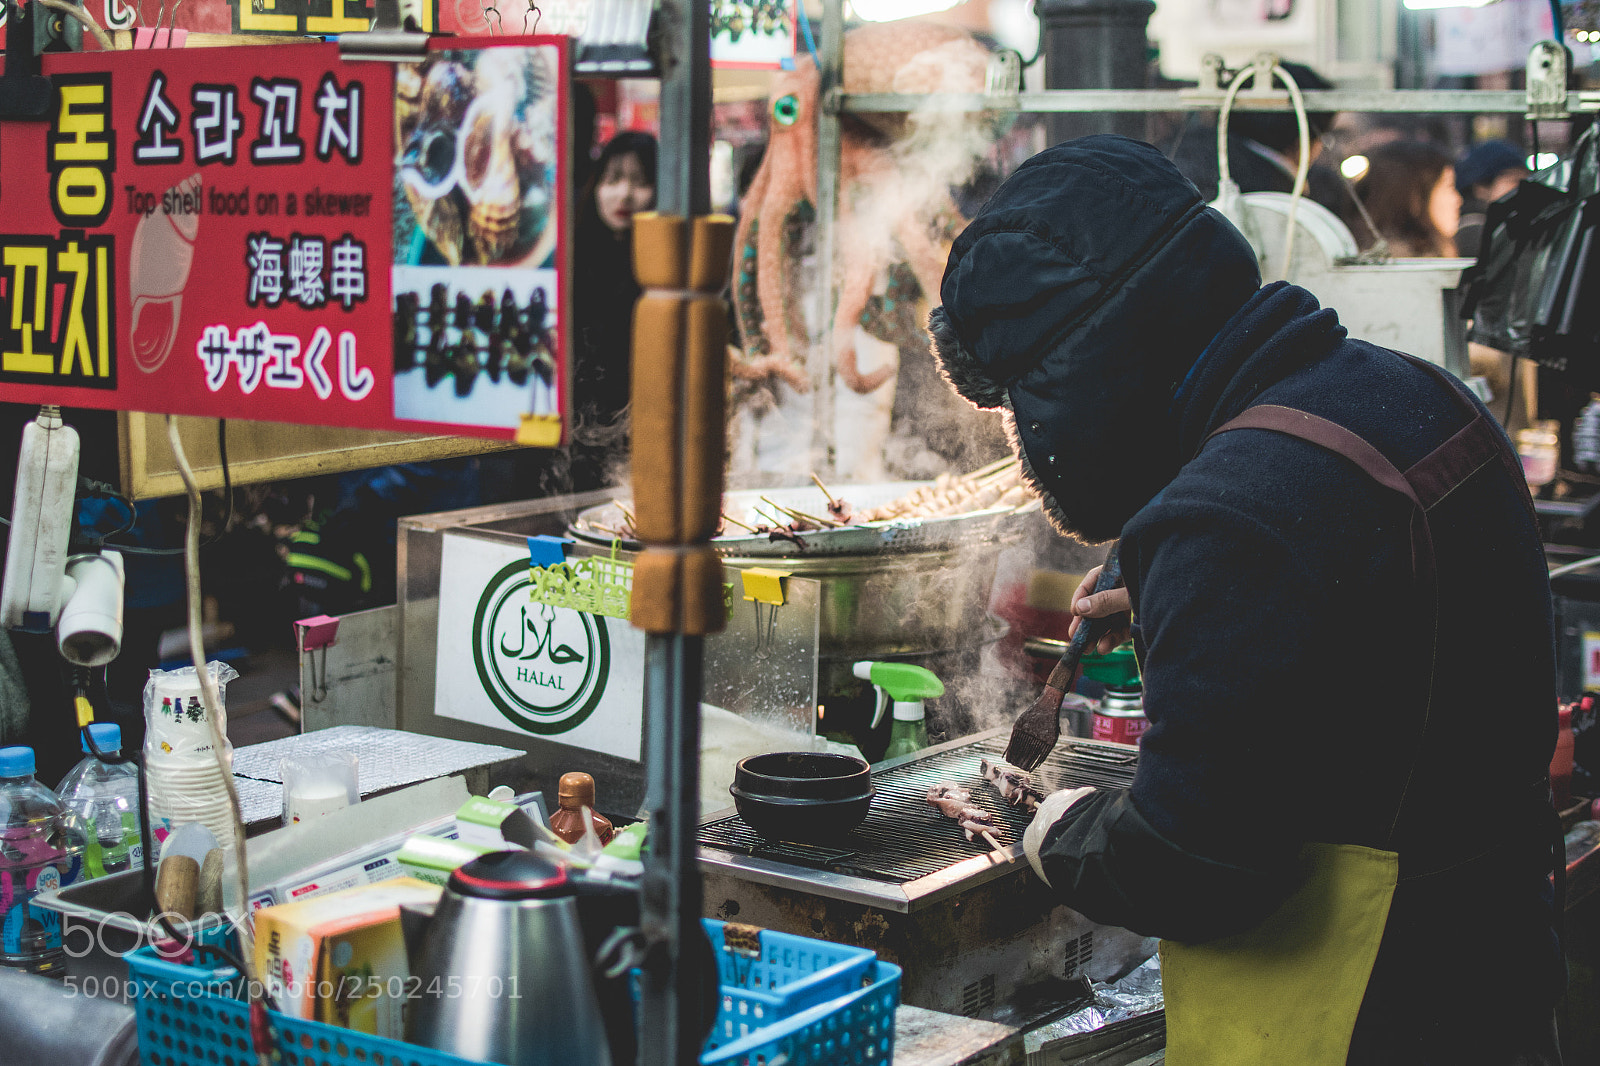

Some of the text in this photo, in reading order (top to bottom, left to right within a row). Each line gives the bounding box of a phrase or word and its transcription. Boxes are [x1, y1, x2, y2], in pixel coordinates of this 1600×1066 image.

[54, 85, 109, 215] 동
[137, 77, 361, 159] 소라꼬치
[125, 184, 372, 218] Top shell food on a skewer
[249, 236, 366, 306] 海螺串
[199, 324, 372, 397] サザエくし
[500, 605, 585, 665] حلال
[516, 666, 565, 691] HALAL
